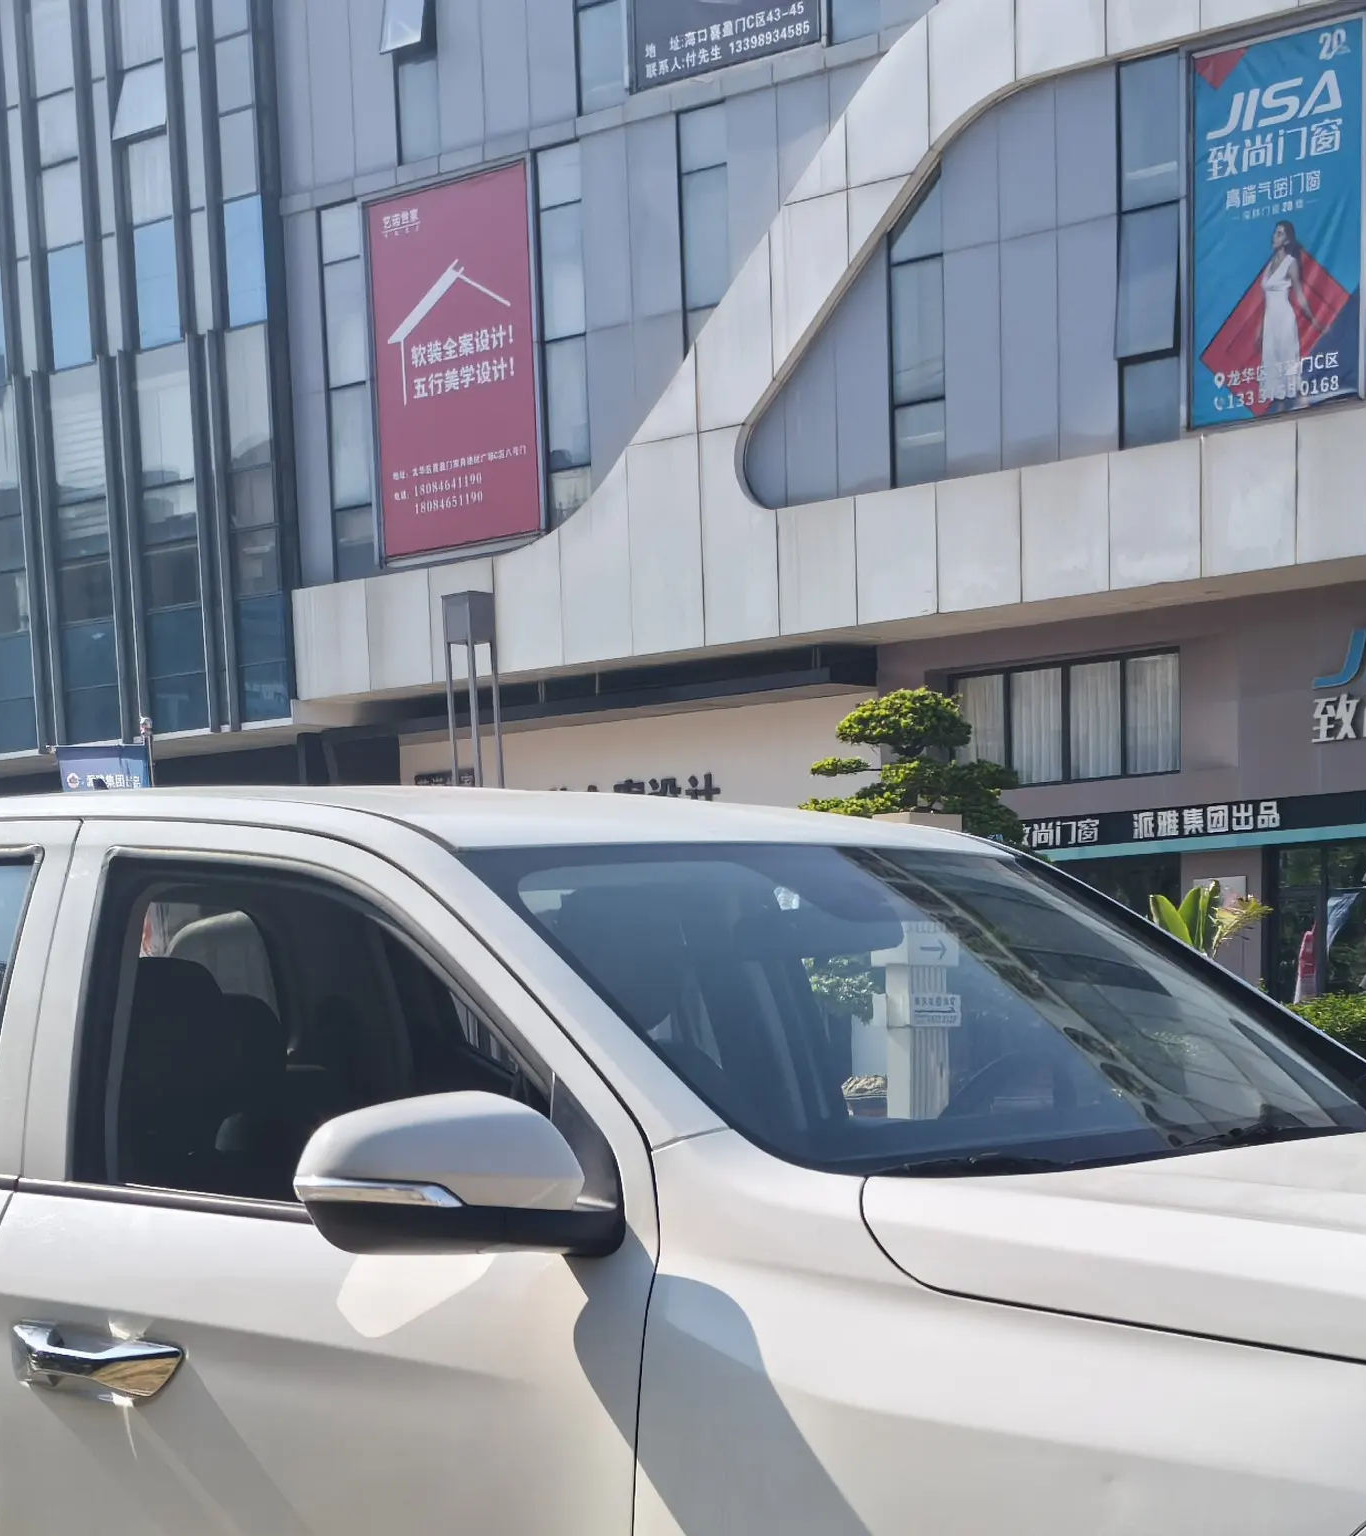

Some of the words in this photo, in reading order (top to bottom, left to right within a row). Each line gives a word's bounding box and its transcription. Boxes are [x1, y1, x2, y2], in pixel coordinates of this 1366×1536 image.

[1206, 69, 1342, 140] JISA
[1206, 118, 1343, 181] 致尚门窗
[413, 356, 515, 399] 五行美学设计!
[1133, 801, 1281, 839] 派雅集团出品
